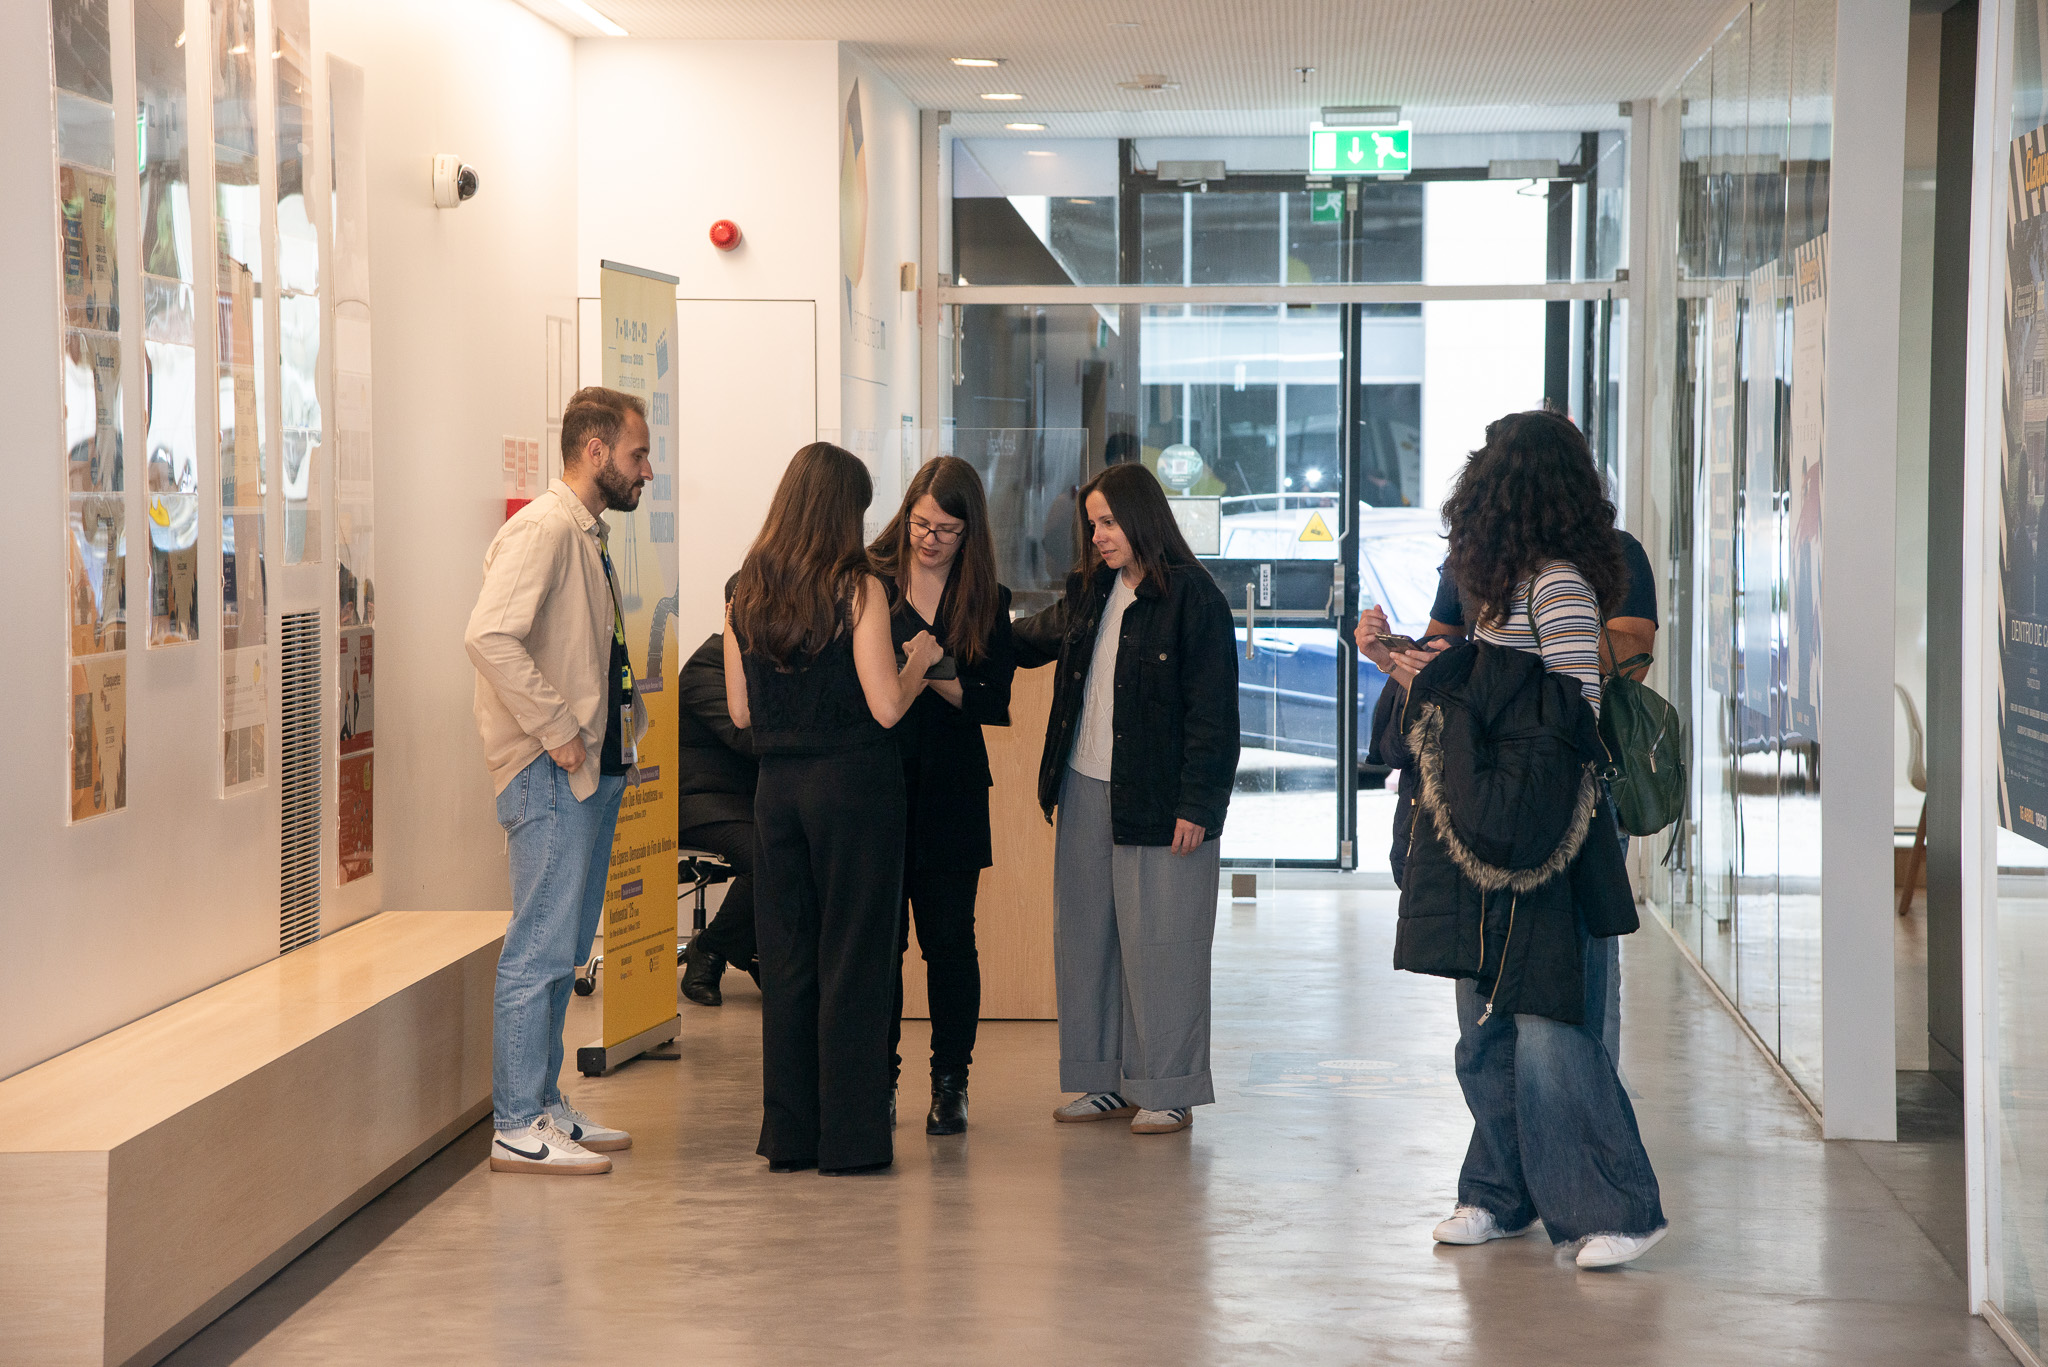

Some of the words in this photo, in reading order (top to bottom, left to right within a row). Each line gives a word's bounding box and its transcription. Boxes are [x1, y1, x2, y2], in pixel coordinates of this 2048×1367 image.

[615, 317, 619, 340] 7
[632, 320, 637, 342] 21
[641, 322, 647, 343] 29
[653, 391, 670, 426] FESTA
[658, 436, 666, 463] DO
[652, 473, 671, 501] CINEMA
[650, 511, 675, 544] ROMENO
[2012, 619, 2034, 645] DENTRO
[2034, 623, 2042, 647] DE
